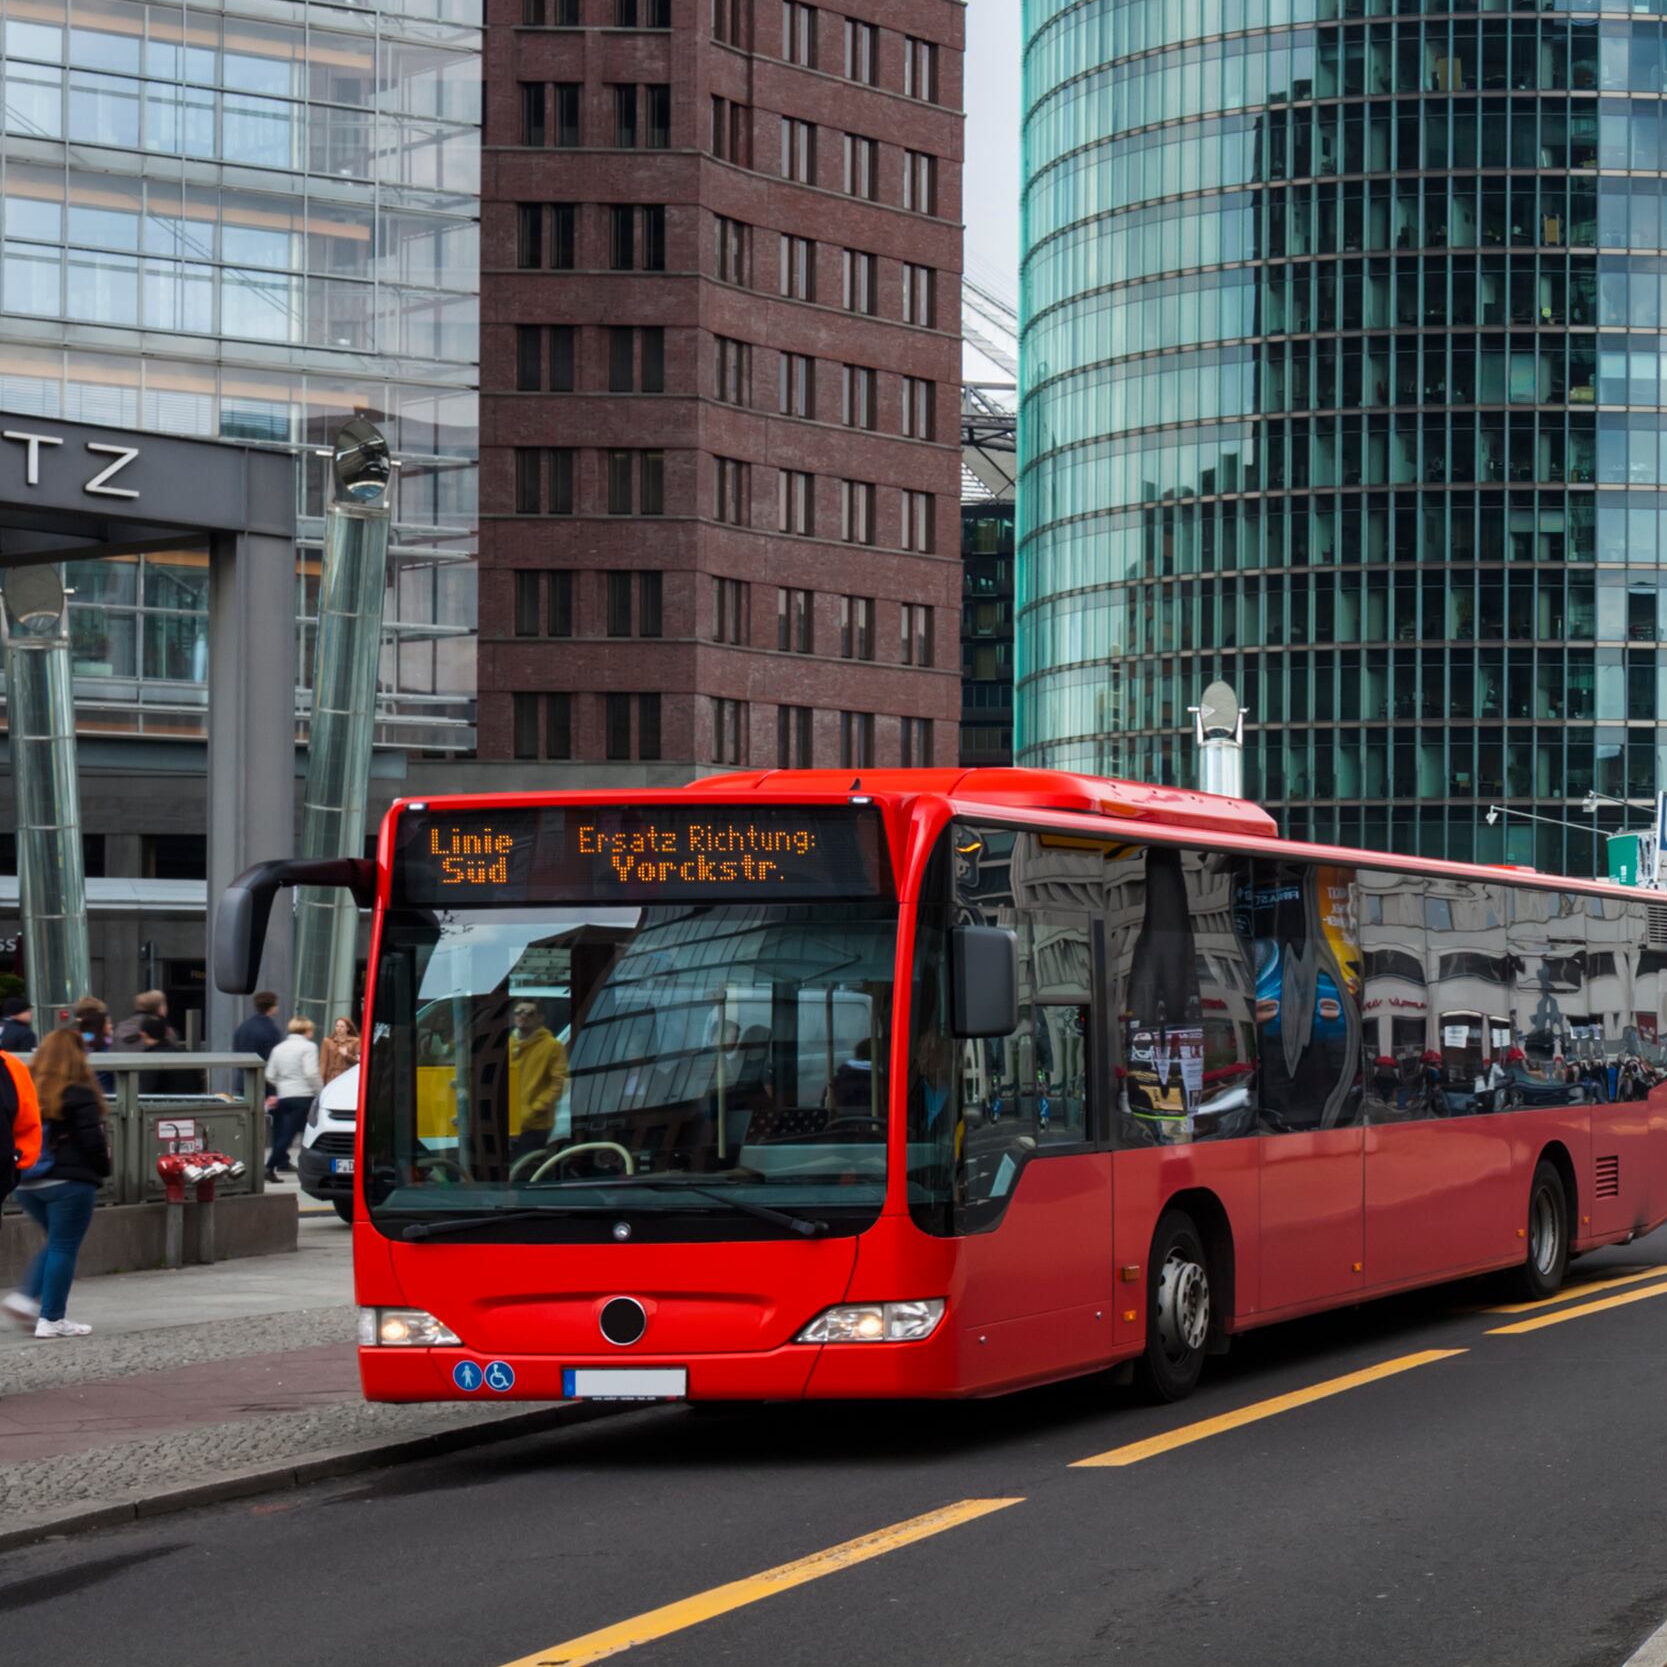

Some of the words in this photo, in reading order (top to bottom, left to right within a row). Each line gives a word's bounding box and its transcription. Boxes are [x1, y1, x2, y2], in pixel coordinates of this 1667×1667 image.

[3, 430, 140, 498] TZ
[431, 827, 513, 855] Linie
[579, 825, 677, 853] Ersatz
[689, 824, 816, 855] Richtung:
[443, 856, 507, 884] Süd
[612, 854, 785, 882] Yorckstr.
